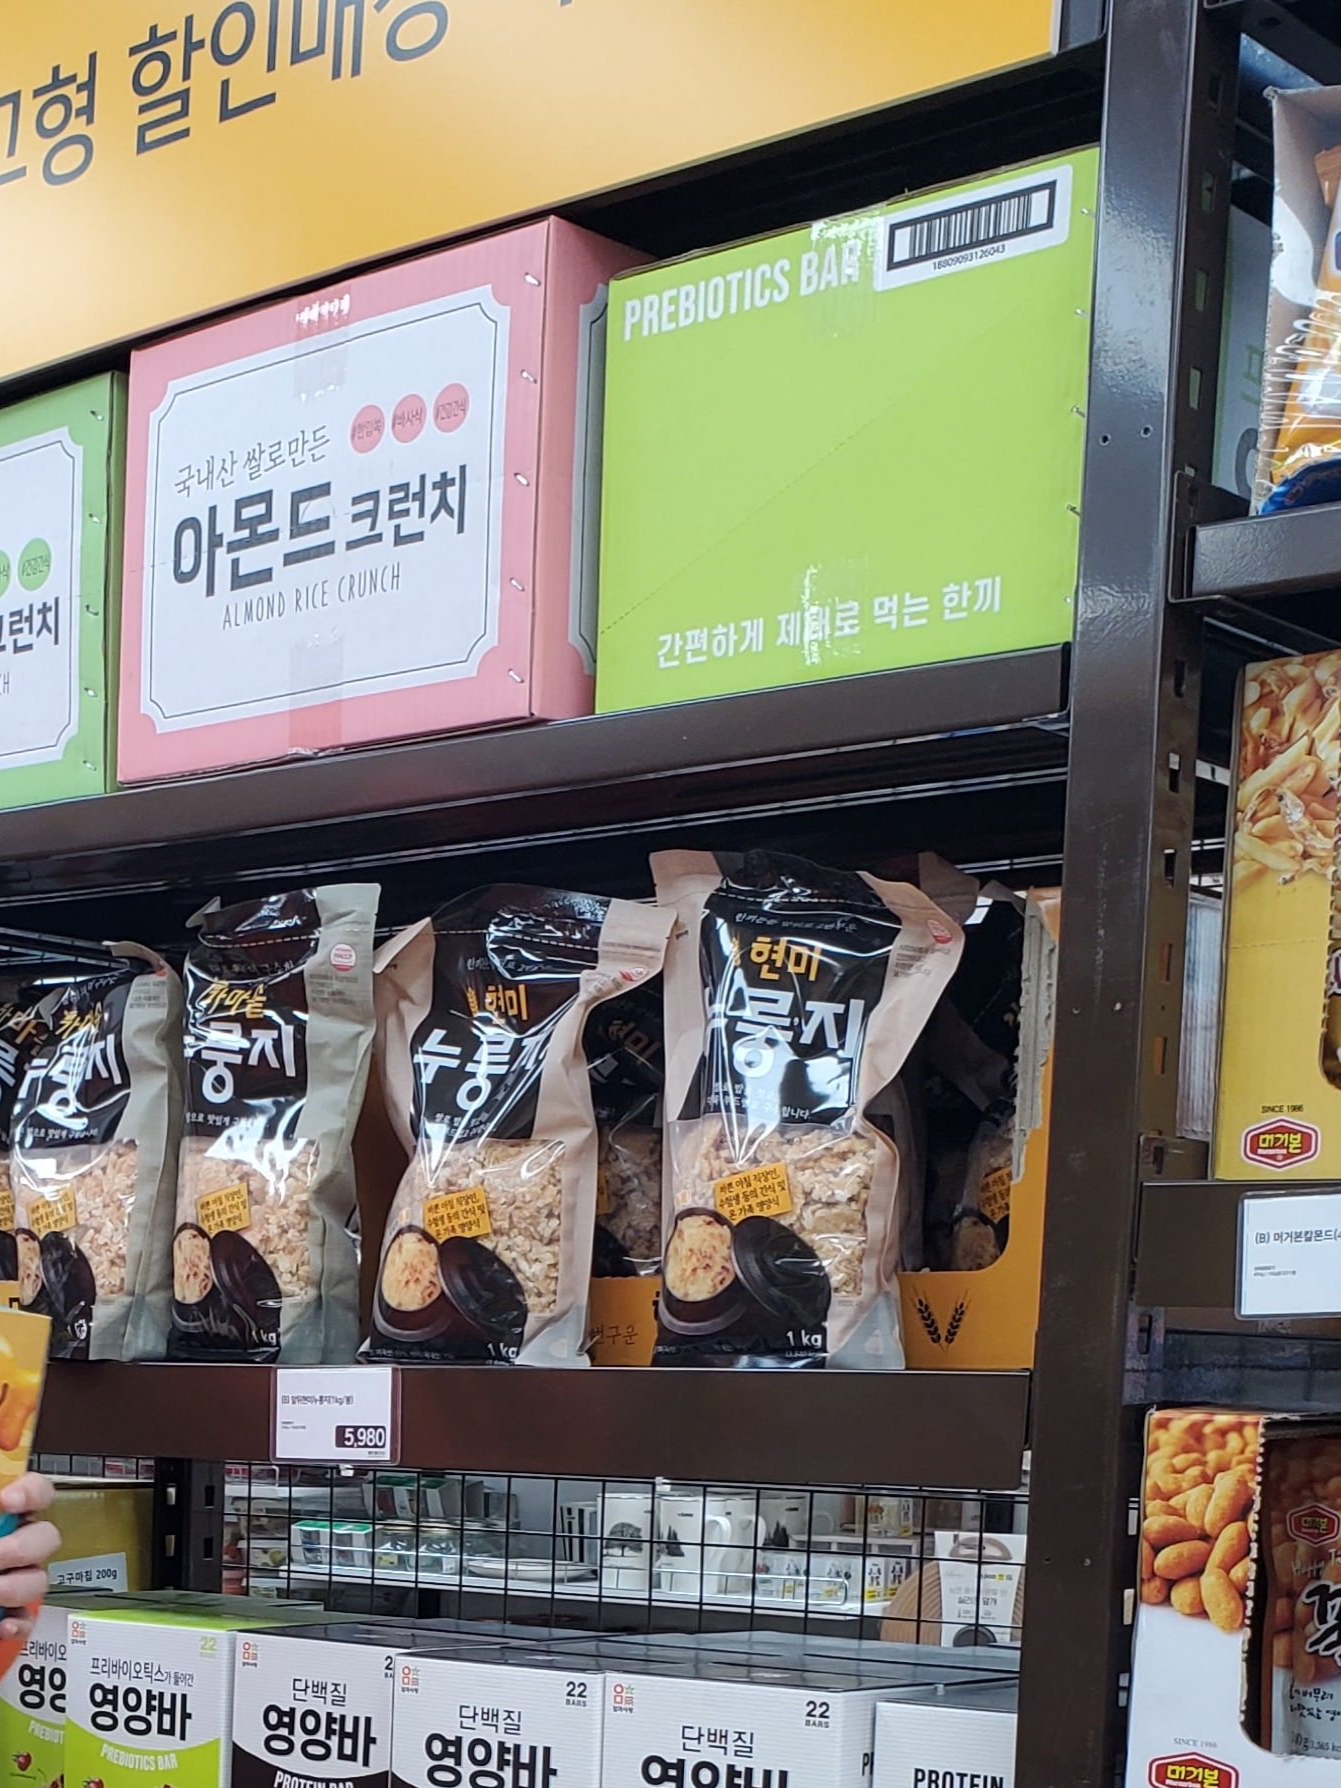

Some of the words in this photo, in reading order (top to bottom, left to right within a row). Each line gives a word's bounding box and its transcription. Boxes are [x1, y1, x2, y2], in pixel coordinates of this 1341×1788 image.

[623, 255, 791, 341] PREBIOTICS
[800, 237, 861, 296] BAR
[174, 449, 239, 499] 국내산
[242, 425, 332, 483] 쌀로만든
[173, 481, 333, 599] 아몬드
[346, 464, 468, 552] 크런치
[222, 592, 287, 631] ALMOND
[294, 580, 330, 613] RICE
[337, 561, 402, 605] CRUNCH
[658, 617, 764, 669] 간편하게
[872, 592, 930, 630] 먹는
[941, 576, 1002, 623] 한끼
[749, 935, 822, 982] 현미
[485, 983, 529, 1026] 현미
[1261, 1105, 1284, 1113] SINCE
[1286, 1104, 1304, 1113] 1986
[1258, 1133, 1303, 1154] 머거본
[1255, 1232, 1270, 1244] (B)
[800, 1329, 823, 1351] kg
[343, 1427, 386, 1448] 5,980
[96, 1568, 117, 1579] 200g
[200, 1636, 218, 1652] 22
[90, 1657, 172, 1685] 프리바이오틱스가
[173, 1671, 195, 1687] 들어간
[292, 1677, 348, 1708] 단백질
[565, 1681, 588, 1699] 22
[89, 1683, 193, 1742] 영양바
[458, 1704, 523, 1735] 단백질
[804, 1719, 830, 1728] BARS
[805, 1700, 830, 1719] 22
[262, 1703, 377, 1769] 영양바
[681, 1725, 754, 1759] 단백질
[1173, 1737, 1198, 1747] SINCE
[100, 1743, 156, 1771] PREBIOTICS
[158, 1753, 179, 1771] BAR
